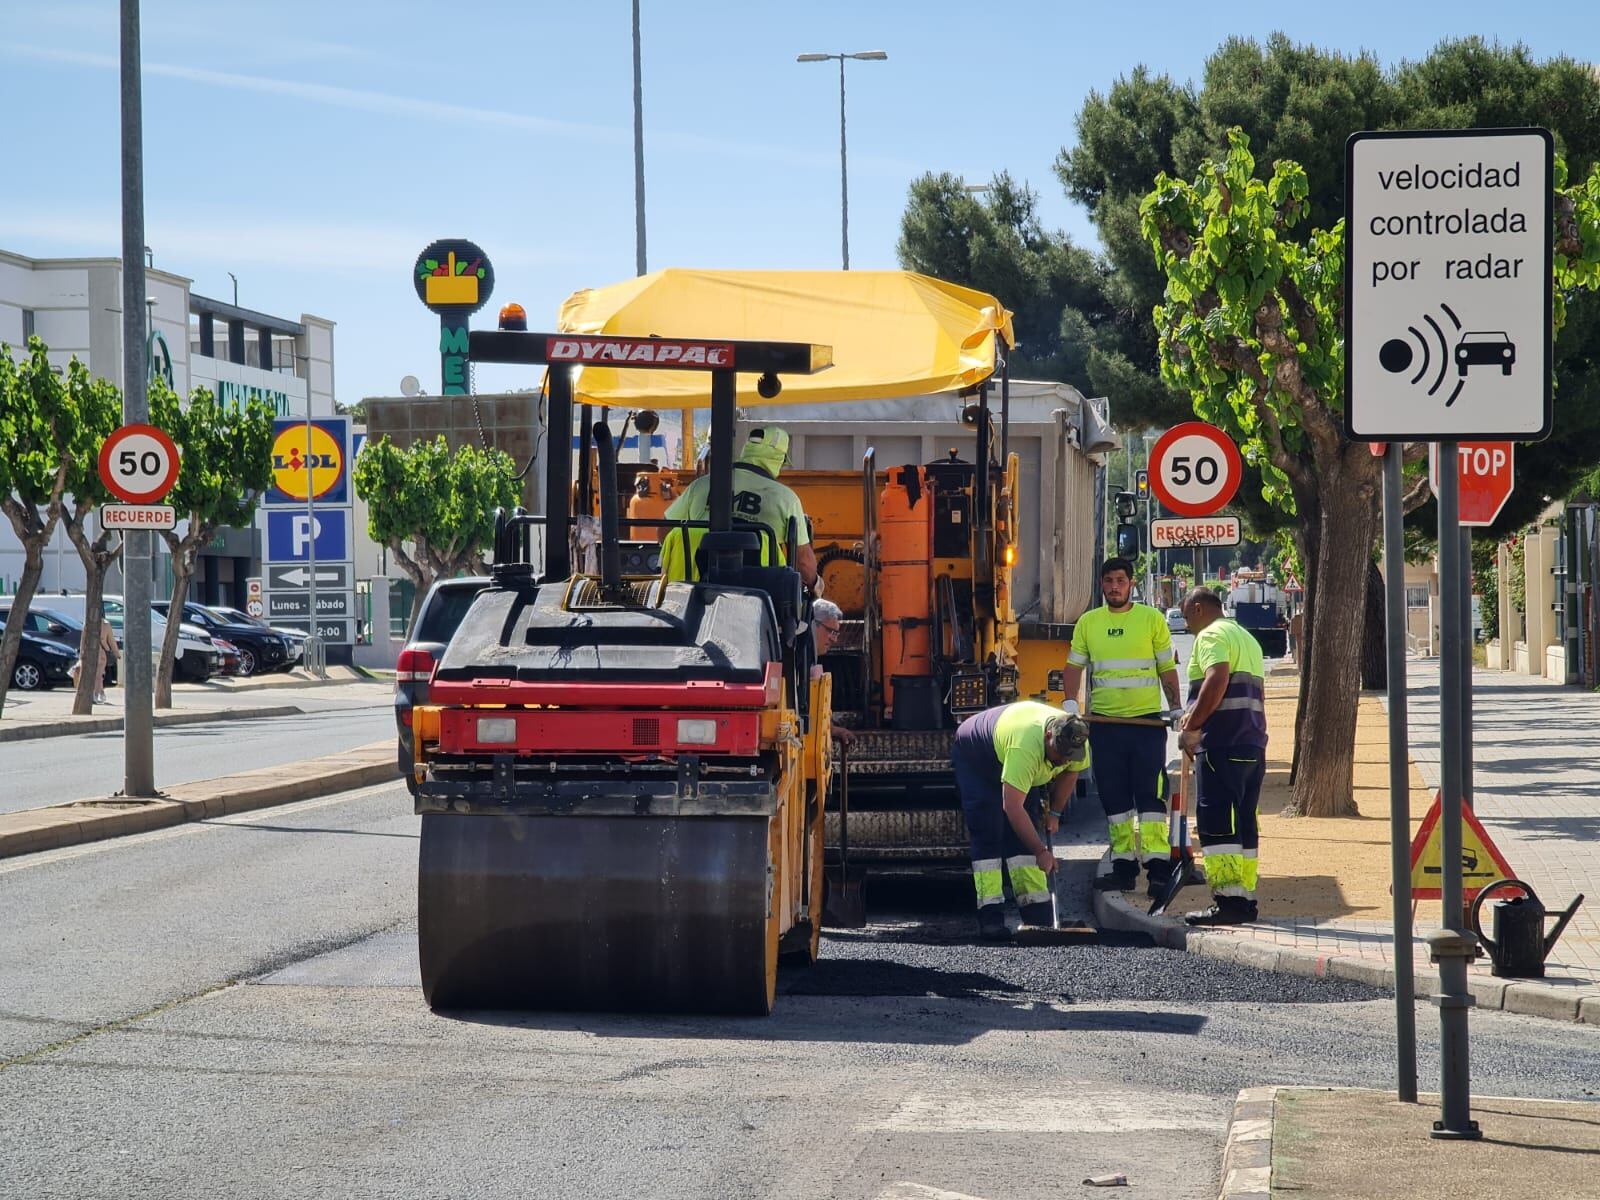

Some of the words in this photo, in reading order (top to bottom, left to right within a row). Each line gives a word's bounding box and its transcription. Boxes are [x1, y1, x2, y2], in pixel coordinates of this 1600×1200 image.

[1378, 161, 1520, 190] velocidad
[1370, 207, 1527, 236] controlada
[1372, 260, 1421, 287] por
[1445, 253, 1524, 280] radar
[551, 341, 728, 365] DYNAPAC
[120, 451, 161, 476] 50
[1171, 456, 1218, 485] 50
[1459, 447, 1506, 476] TOP
[105, 511, 171, 523] RECUERDE
[293, 516, 321, 556] P
[1156, 524, 1235, 540] RECUERDE
[271, 600, 300, 610] Lunes
[315, 599, 345, 609] ábado
[317, 626, 340, 637] 2:00
